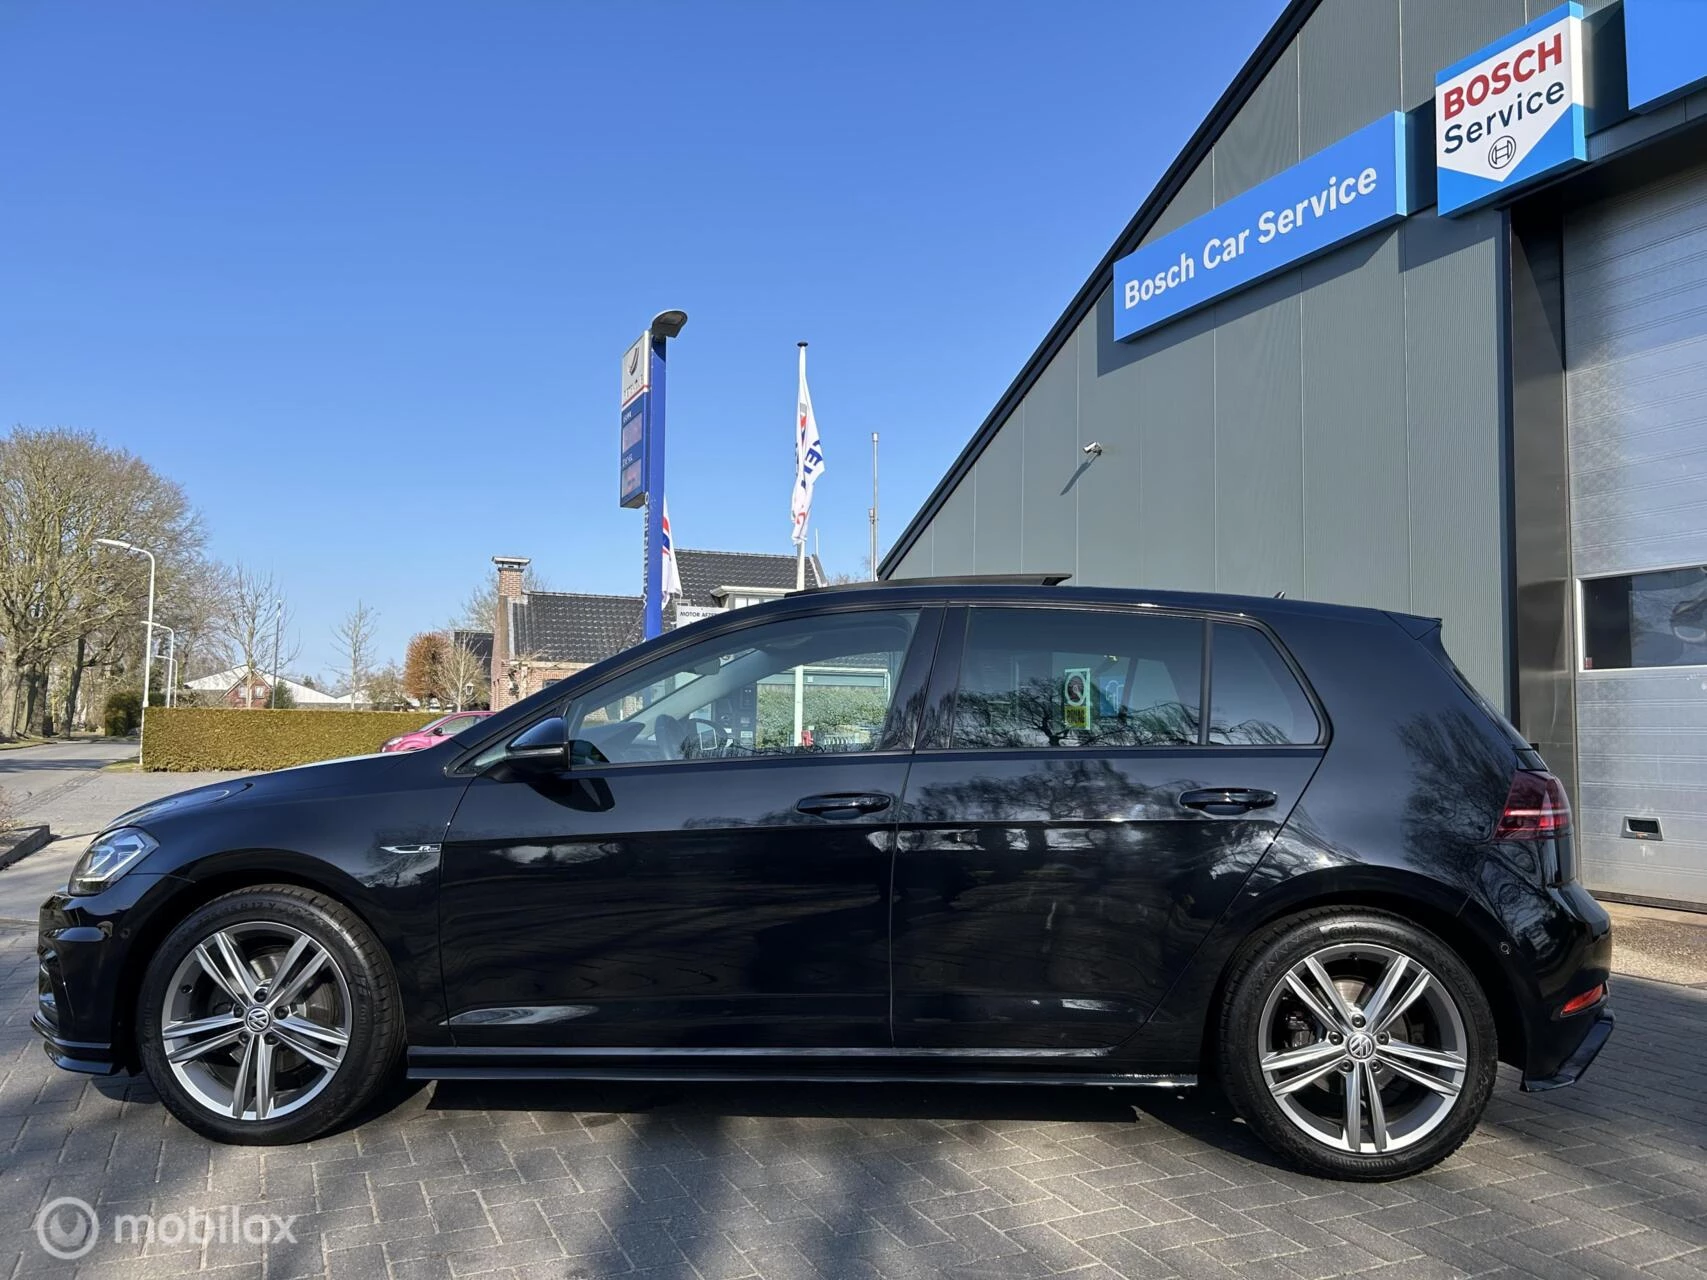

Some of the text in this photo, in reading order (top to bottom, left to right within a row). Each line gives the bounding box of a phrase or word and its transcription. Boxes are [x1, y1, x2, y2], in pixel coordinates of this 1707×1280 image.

[1443, 81, 1565, 154] Service
[1444, 33, 1562, 121] BOSCH
[1124, 167, 1378, 310] Bosch Car Service
